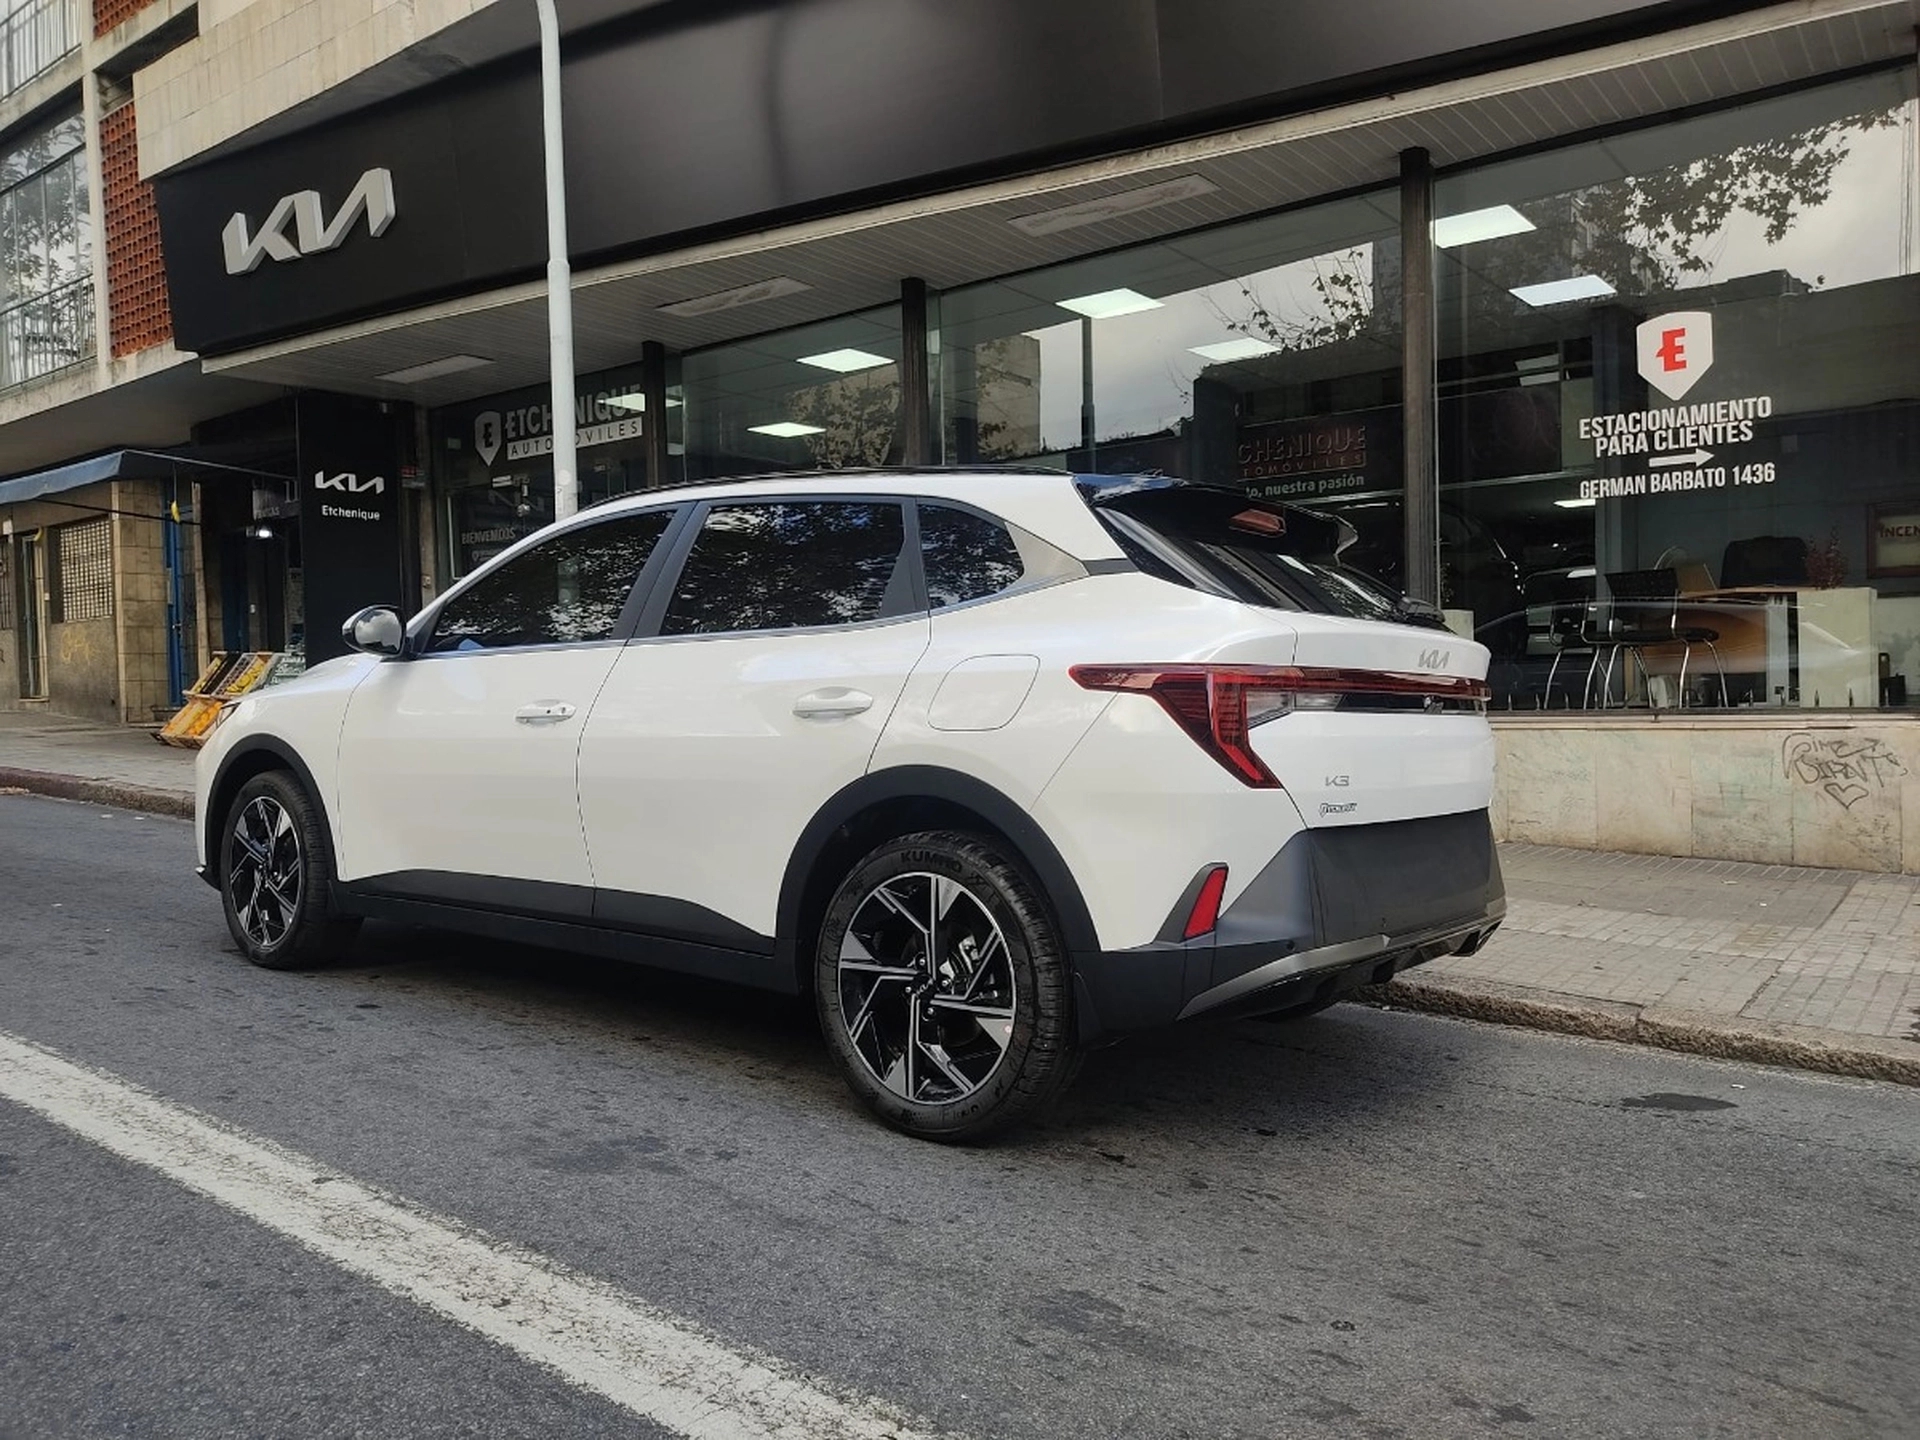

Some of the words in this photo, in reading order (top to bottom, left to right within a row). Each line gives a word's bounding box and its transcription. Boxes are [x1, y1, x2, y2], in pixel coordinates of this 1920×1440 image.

[222, 167, 396, 277] KIA
[505, 384, 641, 438] ETCHNIQU
[1579, 396, 1772, 440] ESTACIONAMIENTO
[511, 421, 638, 457] AUTOVILES
[1596, 433, 1649, 458] PARA
[1654, 420, 1754, 451] CLIENTES
[315, 470, 384, 495] KIA
[1265, 480, 1315, 496] nuestra
[1318, 474, 1365, 493] pasión
[1580, 474, 1646, 499] GERMAN
[1651, 467, 1726, 493] BARBATO
[1732, 462, 1775, 485] 1436
[322, 505, 380, 521] Etchenique
[1325, 775, 1350, 787] K3
